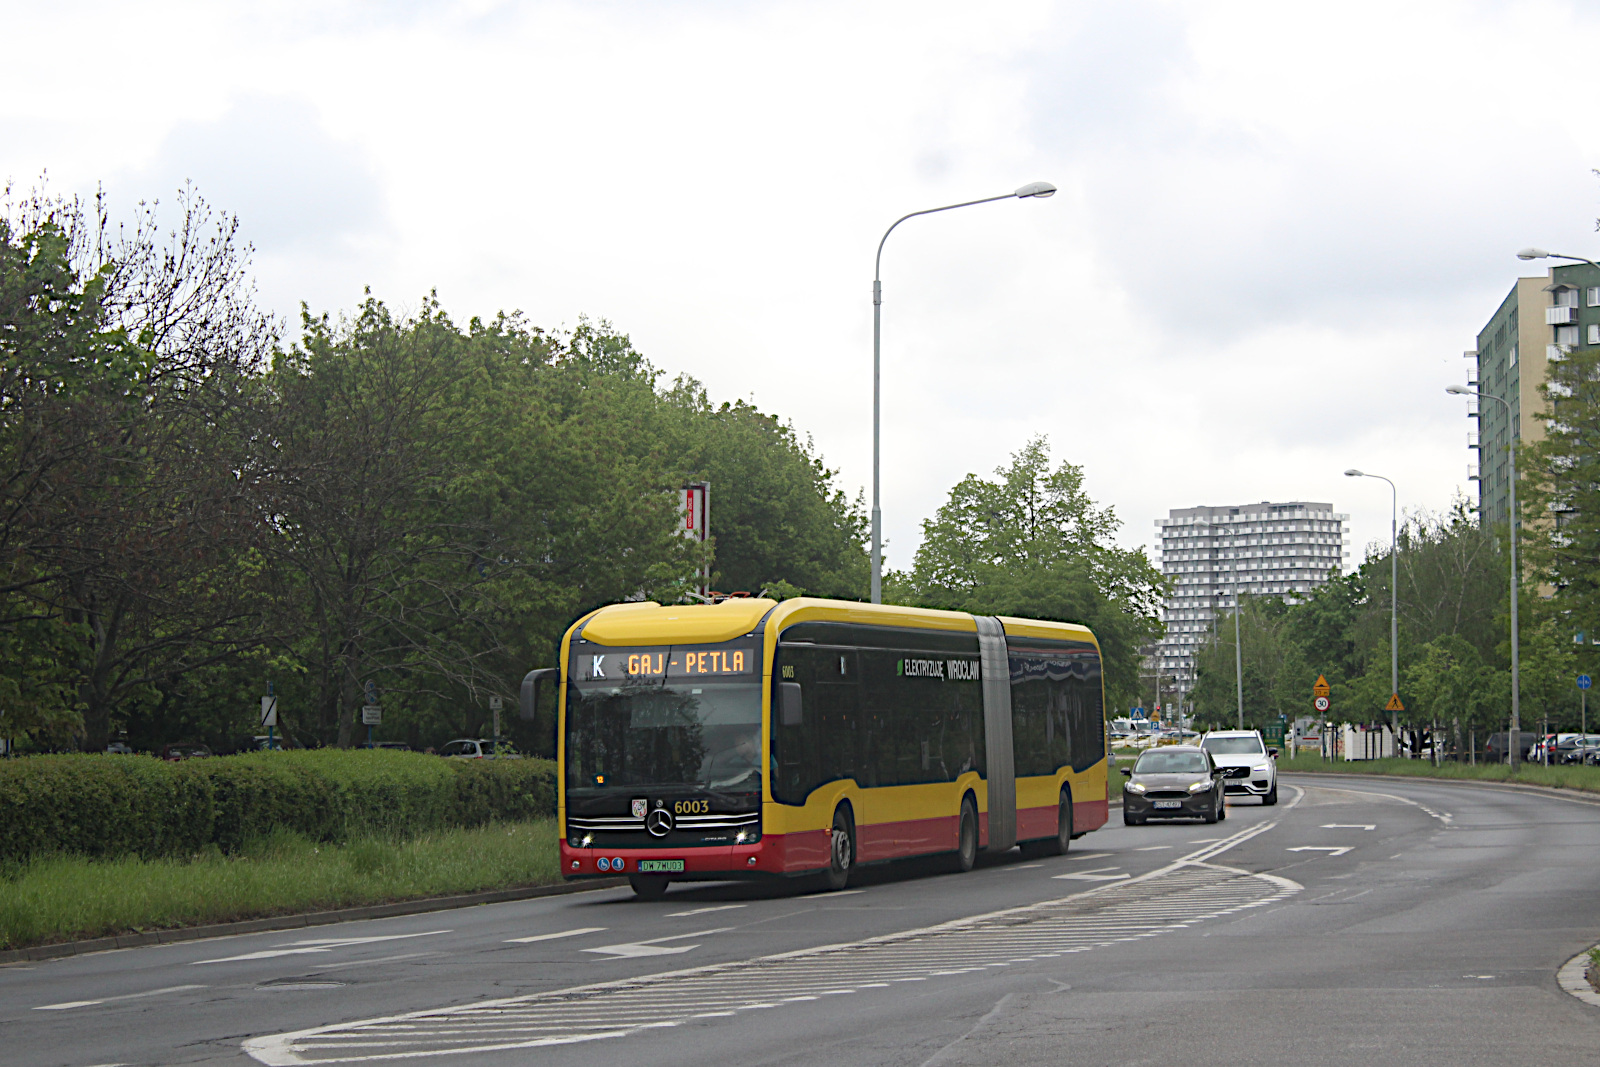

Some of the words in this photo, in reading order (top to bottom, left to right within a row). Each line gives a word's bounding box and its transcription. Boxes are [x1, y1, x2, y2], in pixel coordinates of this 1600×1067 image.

[593, 655, 605, 677] K
[628, 653, 663, 675] GAJ
[685, 650, 744, 673] PĘTLA
[904, 658, 944, 681] ELEKTRYZUJĘ
[946, 659, 980, 681] WROCŁAW
[782, 665, 795, 678] 6003
[1317, 700, 1327, 708] 30
[674, 800, 709, 814] 6003
[643, 861, 654, 871] DW
